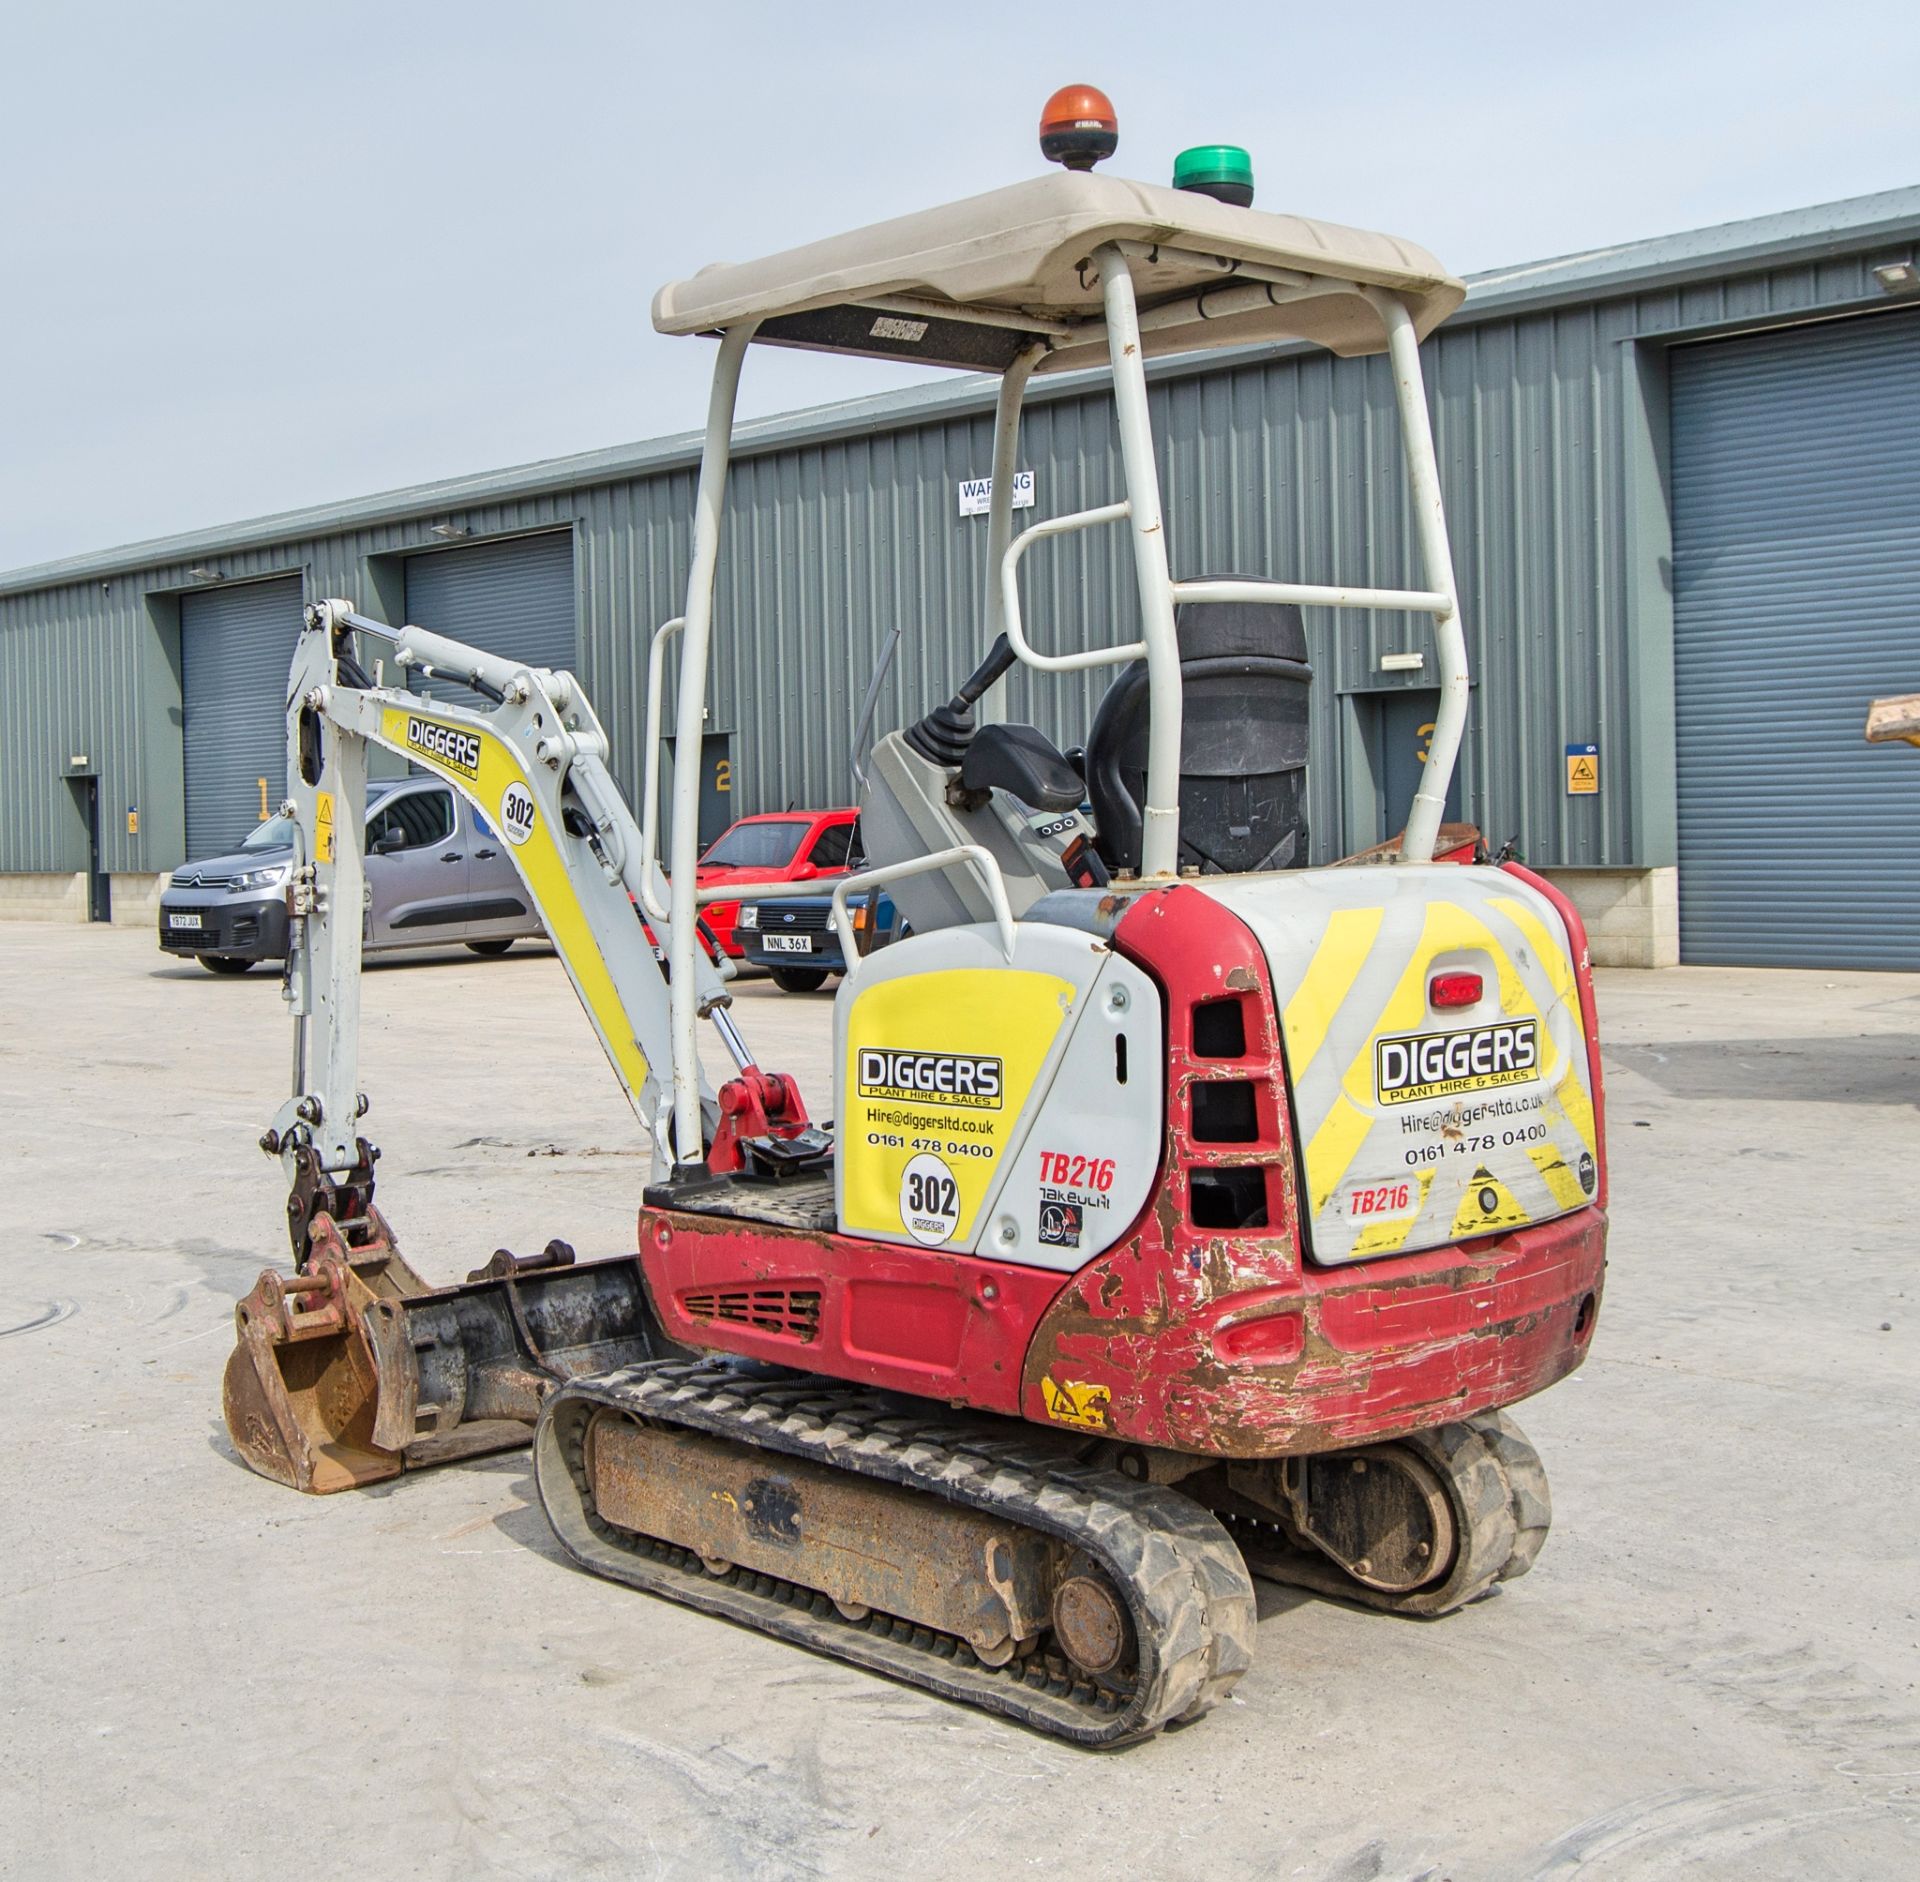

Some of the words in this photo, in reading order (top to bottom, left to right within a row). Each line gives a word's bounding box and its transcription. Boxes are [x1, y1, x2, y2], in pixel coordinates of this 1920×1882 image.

[963, 474, 1030, 498] WANG
[409, 719, 479, 768] DIGGERS
[716, 759, 731, 791] 2
[506, 793, 534, 830] 302
[767, 937, 785, 950] NNL
[788, 937, 808, 950] 36X
[1382, 1025, 1535, 1090] DIGGERS
[862, 1052, 999, 1096] DIGGERS
[1390, 1084, 1436, 1101] PLANT
[1440, 1078, 1472, 1096] HIRE
[1476, 1077, 1486, 1087] &
[1490, 1070, 1529, 1085] SALES
[869, 1086, 906, 1098] PLANT
[910, 1091, 935, 1101] HIRE
[939, 1093, 947, 1102] &
[952, 1094, 992, 1106] SALES
[867, 1108, 994, 1134] Hire@diggersltd.co.uk
[867, 1133, 904, 1147] 0161
[911, 1138, 941, 1152] 478
[947, 1142, 993, 1158] 0400
[1405, 1144, 1445, 1165] 0161
[1453, 1135, 1495, 1154] 478
[1502, 1124, 1547, 1145] 0400
[1039, 1151, 1116, 1192] TB216
[909, 1173, 956, 1217] 302
[1352, 1184, 1409, 1215] TB216
[913, 1219, 944, 1231] DIGGERS
